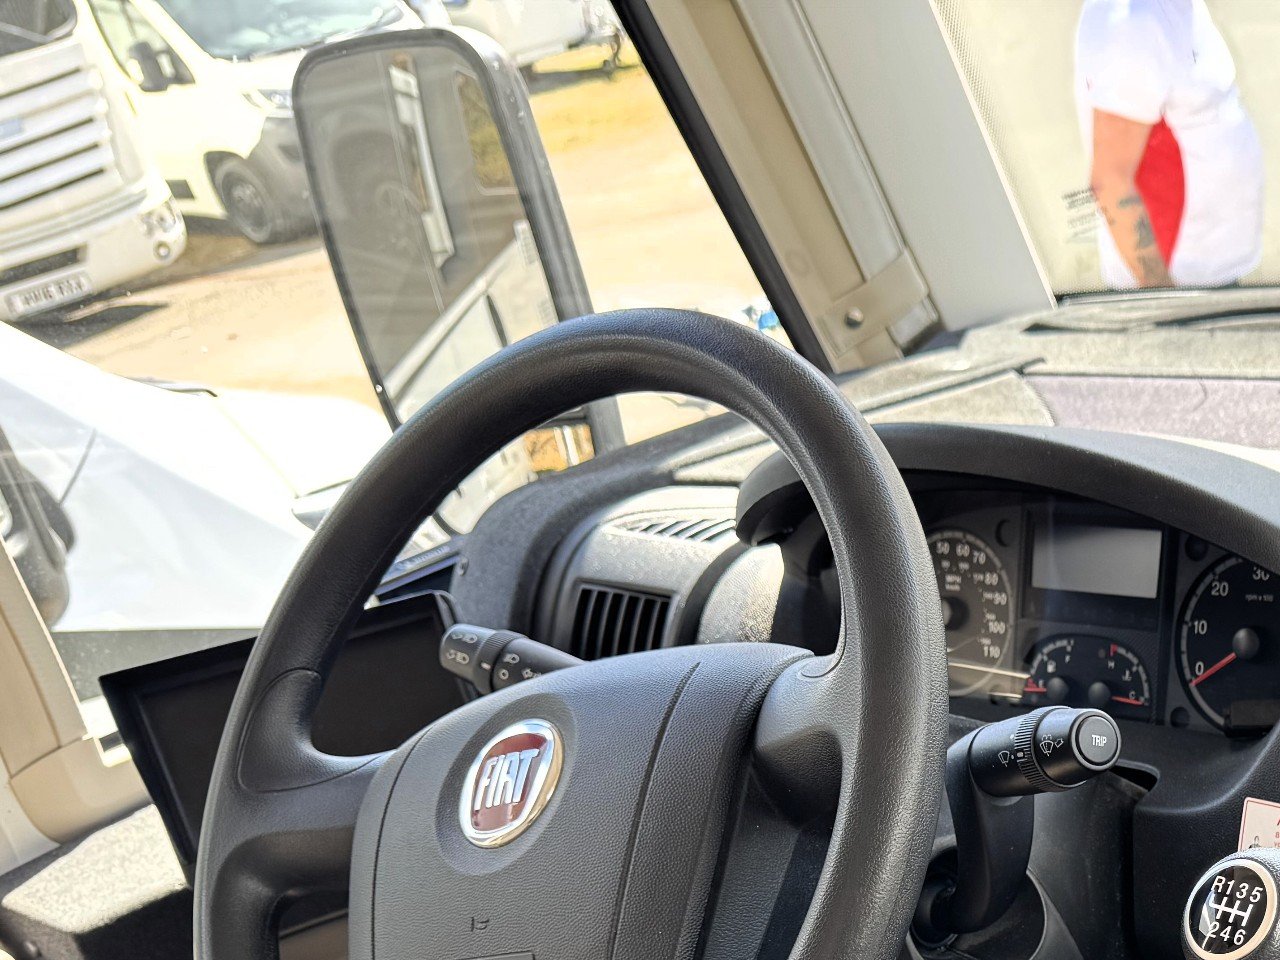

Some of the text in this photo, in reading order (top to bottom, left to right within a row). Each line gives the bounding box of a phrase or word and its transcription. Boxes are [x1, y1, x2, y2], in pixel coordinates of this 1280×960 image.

[1211, 581, 1229, 597] 20
[1194, 620, 1207, 635] 10
[1195, 661, 1204, 675] 0
[1091, 734, 1107, 747] TRIP
[474, 748, 540, 811] FIAT
[1210, 875, 1264, 903] R 1 3 5
[1208, 921, 1246, 946] 2 4 6
